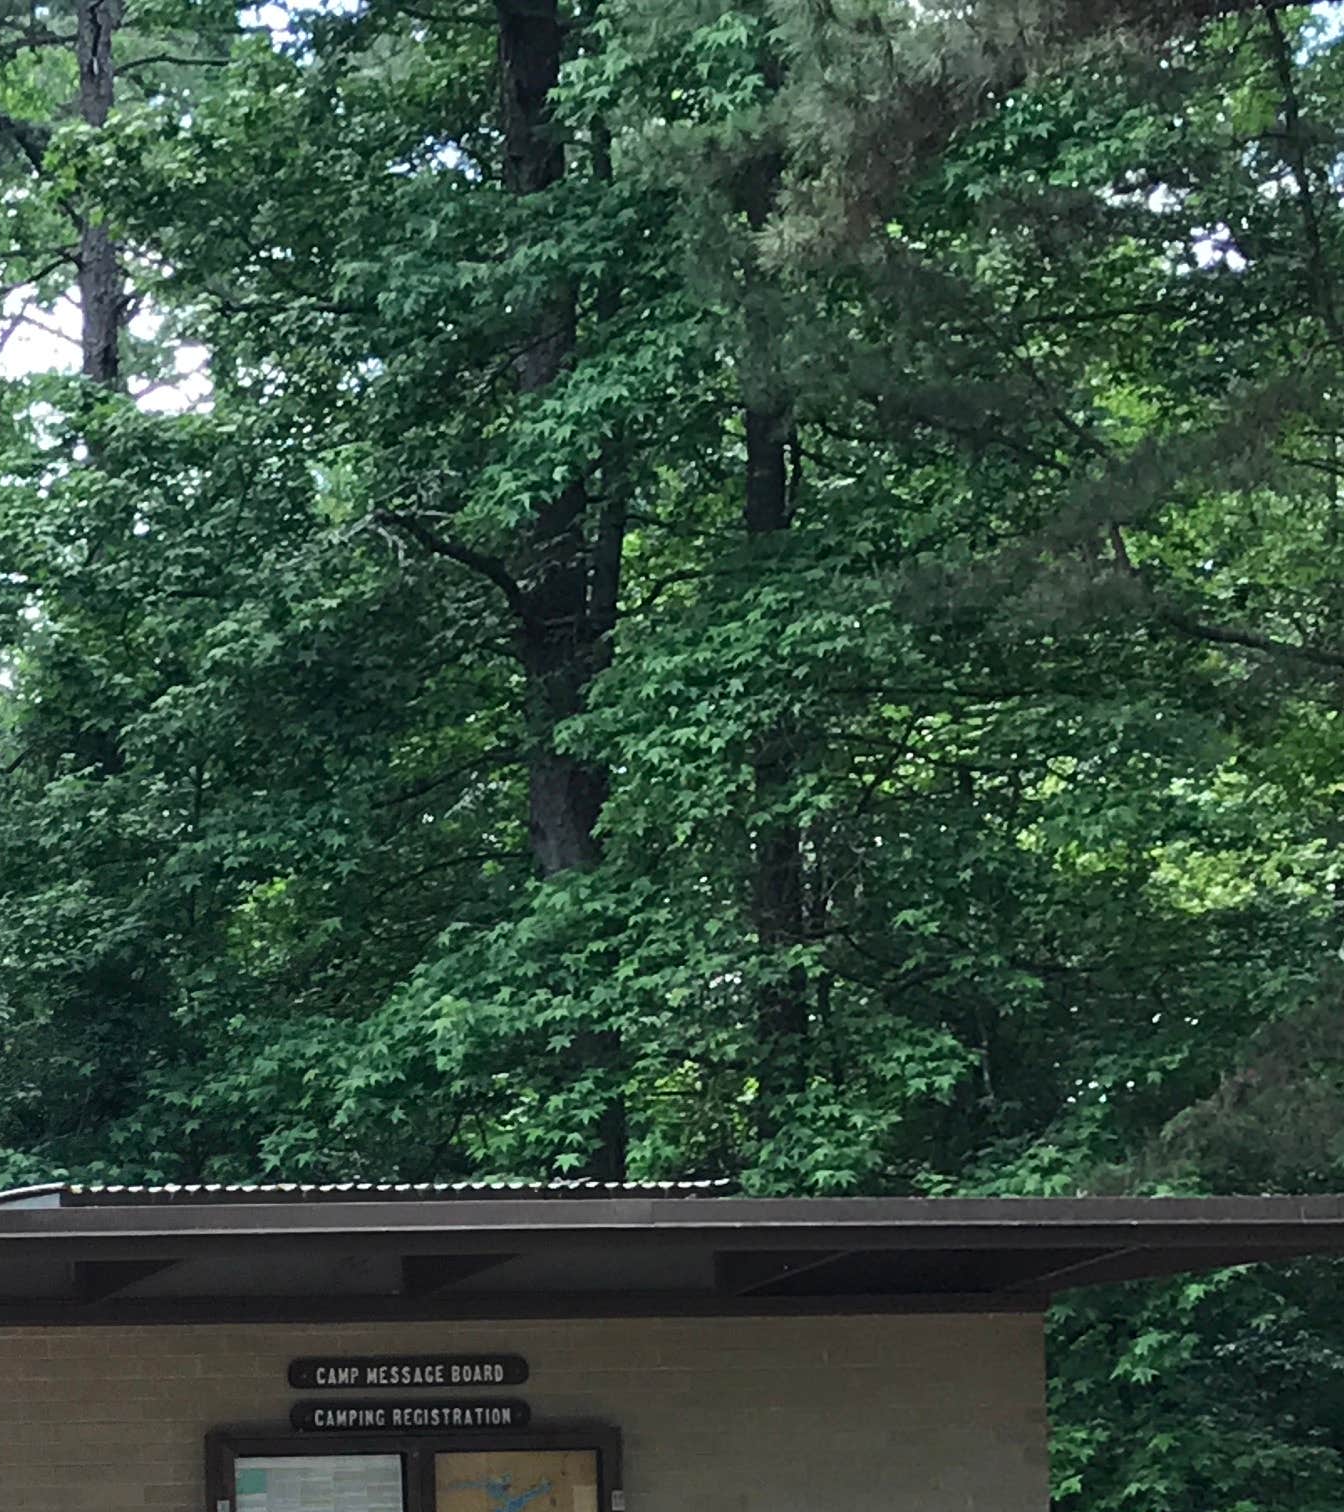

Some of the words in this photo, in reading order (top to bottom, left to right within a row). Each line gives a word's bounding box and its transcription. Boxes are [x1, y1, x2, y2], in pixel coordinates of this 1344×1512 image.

[316, 1366, 360, 1385] CAMP
[366, 1365, 444, 1384] MESSAGE
[451, 1364, 504, 1383] BOARD
[314, 1409, 386, 1427] CAMPING
[392, 1407, 511, 1427] REGISTRATION
